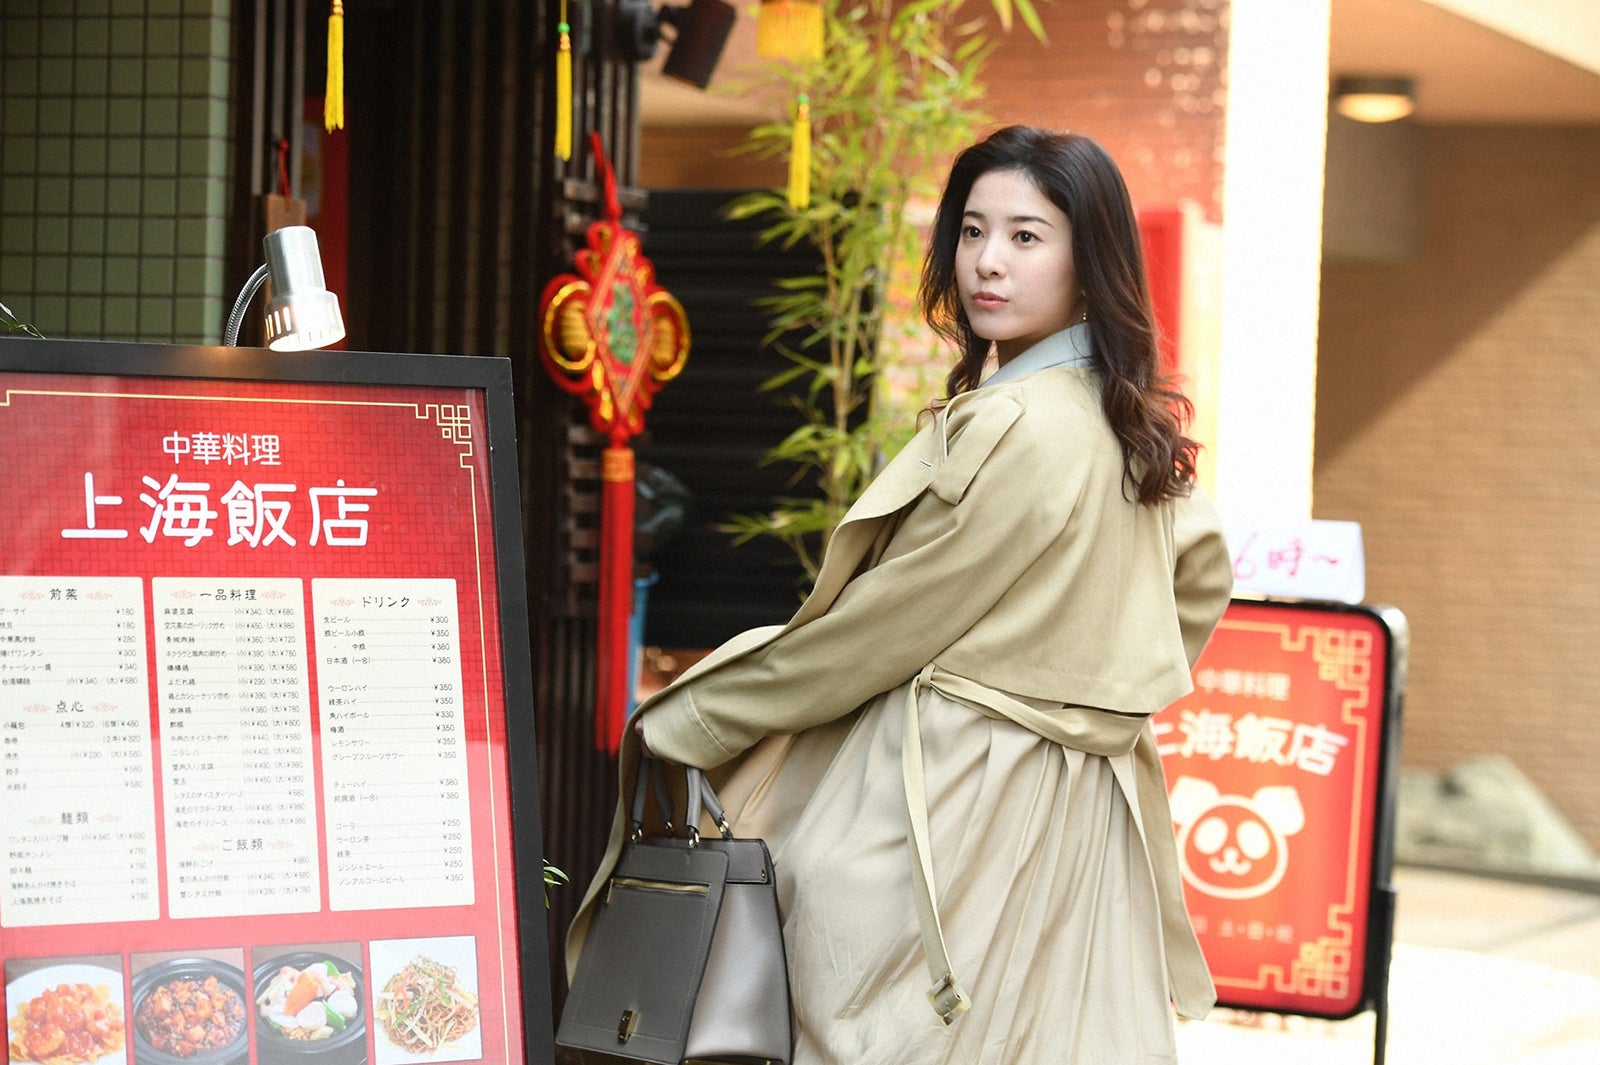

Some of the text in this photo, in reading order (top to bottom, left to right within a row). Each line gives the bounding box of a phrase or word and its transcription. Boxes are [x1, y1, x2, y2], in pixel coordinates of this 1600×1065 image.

[162, 431, 282, 467] 中華料理
[61, 471, 378, 549] 上海飯店
[50, 588, 78, 601] 前菜
[200, 588, 257, 601] 一品料理
[362, 596, 410, 608] ドリンク
[323, 616, 449, 624] 生ビール ¥300
[328, 684, 368, 692] ウーロンハイ
[434, 697, 454, 705] ¥350
[56, 700, 84, 713] 点心
[436, 724, 455, 732] ¥350
[331, 738, 456, 748] レモンサワー ¥350
[438, 751, 457, 759] ¥350
[333, 781, 367, 789] チューハイ
[336, 819, 460, 830] コーラ ¥250
[443, 833, 461, 841] ¥250
[222, 838, 264, 852] ご飯類
[444, 847, 462, 855] ¥250
[444, 860, 463, 868] ¥250
[445, 874, 464, 882] ¥350
